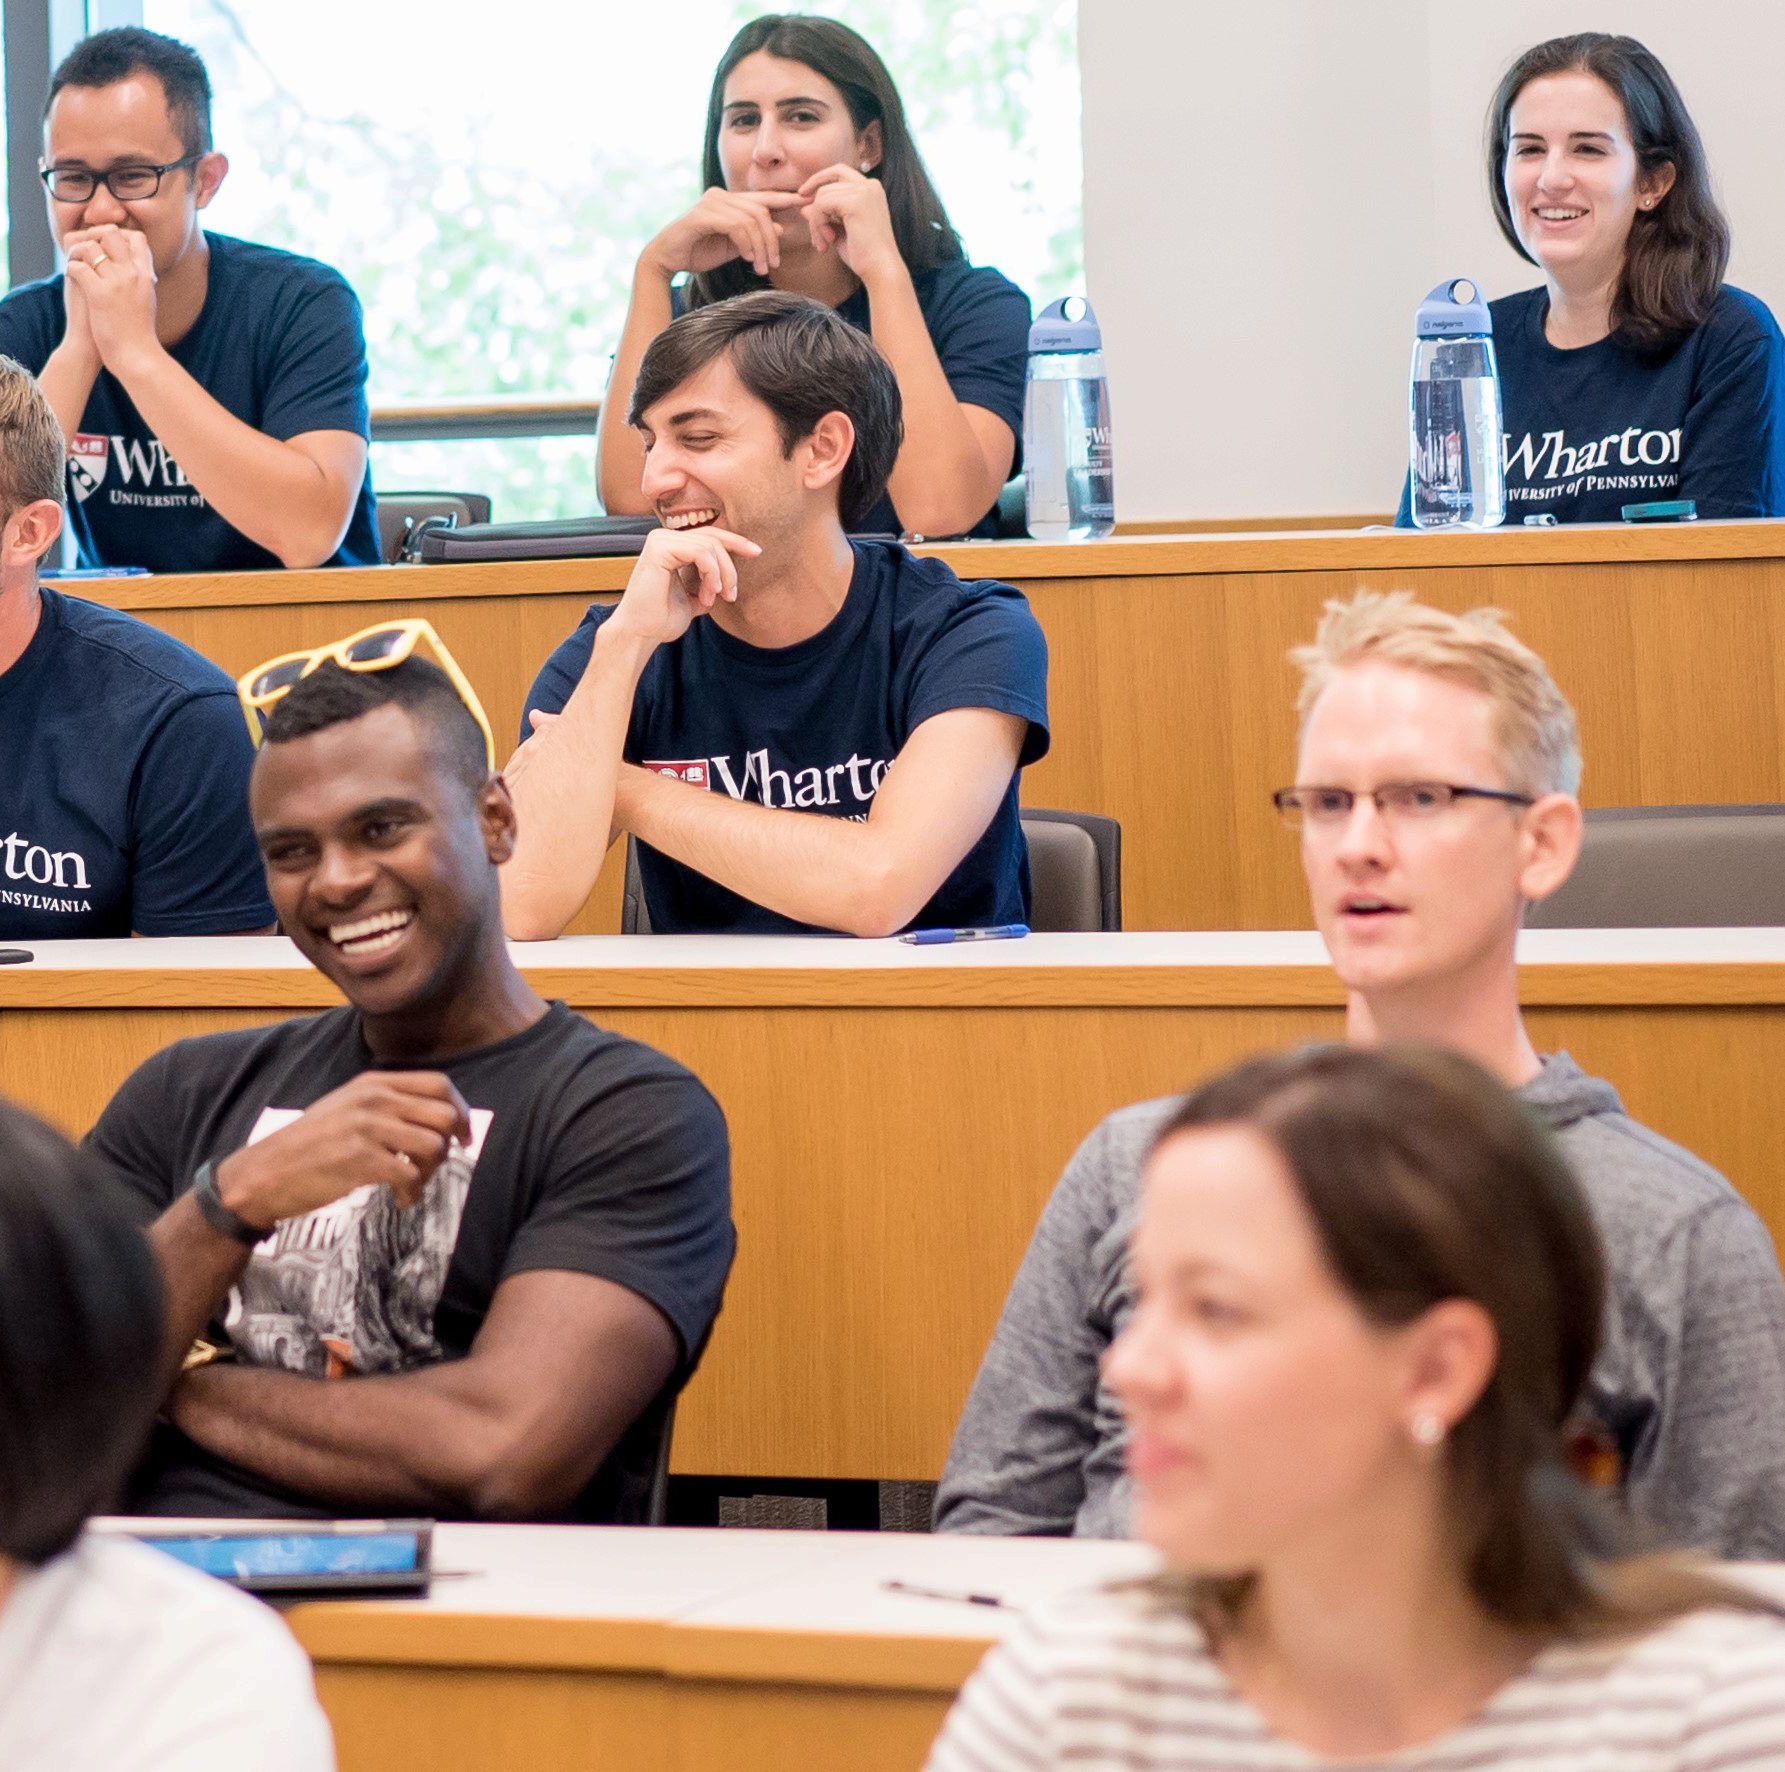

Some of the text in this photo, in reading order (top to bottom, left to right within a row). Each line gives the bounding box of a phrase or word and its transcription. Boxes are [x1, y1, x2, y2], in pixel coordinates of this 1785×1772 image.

[110, 435, 193, 487] Wh
[110, 490, 187, 507] UNIVERSITY
[1505, 483, 1565, 501] IVERSITY
[1566, 475, 1586, 497] of
